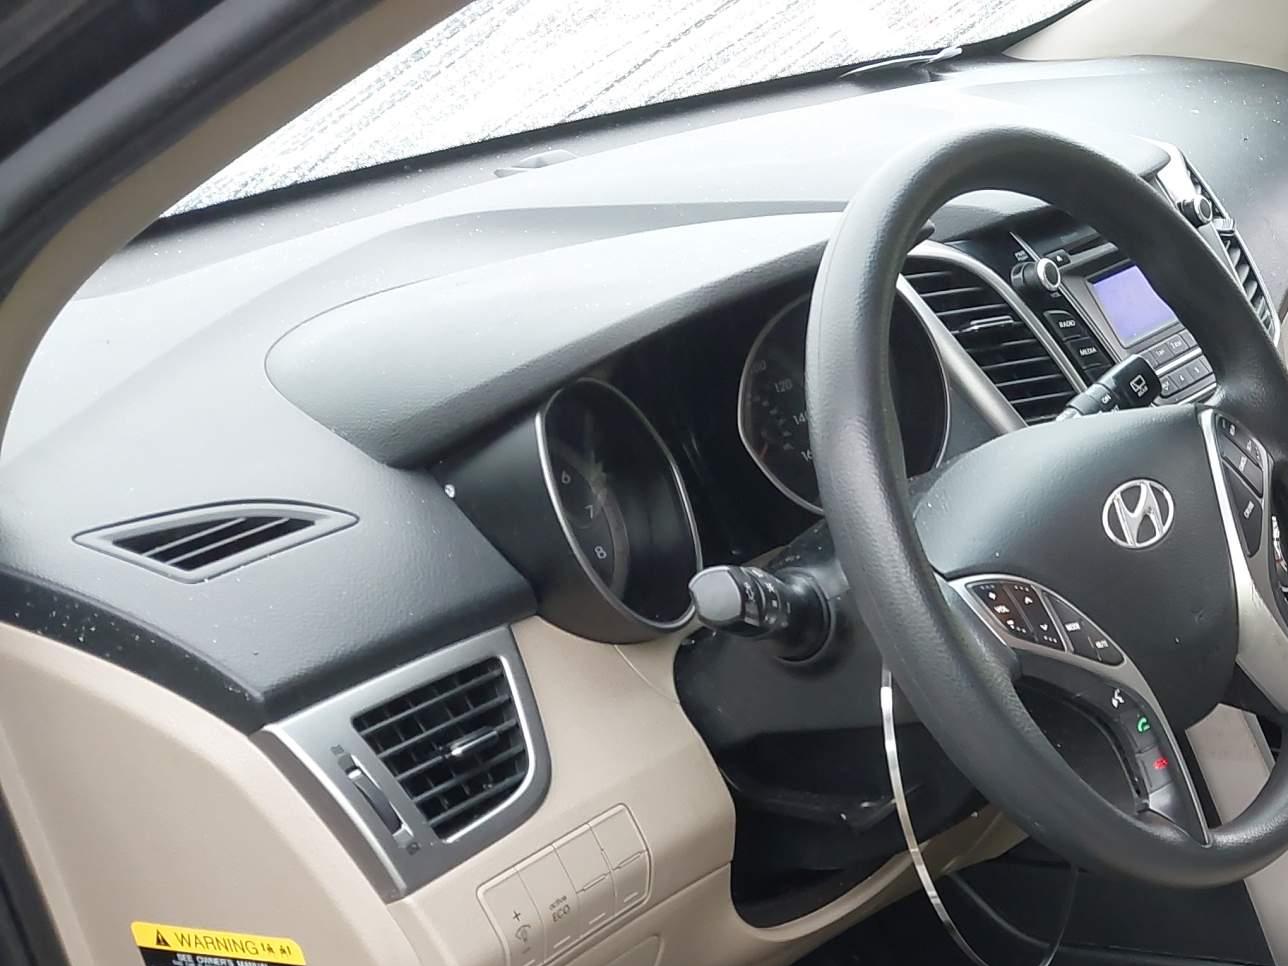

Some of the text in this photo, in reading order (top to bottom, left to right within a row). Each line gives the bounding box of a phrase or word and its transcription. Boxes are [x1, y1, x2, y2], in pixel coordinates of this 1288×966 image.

[1058, 319, 1076, 328] RADIO
[1079, 346, 1097, 356] MEDIA
[774, 377, 793, 394] 120
[560, 470, 572, 485] 6
[583, 504, 595, 520] 7
[593, 545, 608, 560] 8
[551, 904, 570, 922] ECO
[174, 931, 260, 956] WARNING
